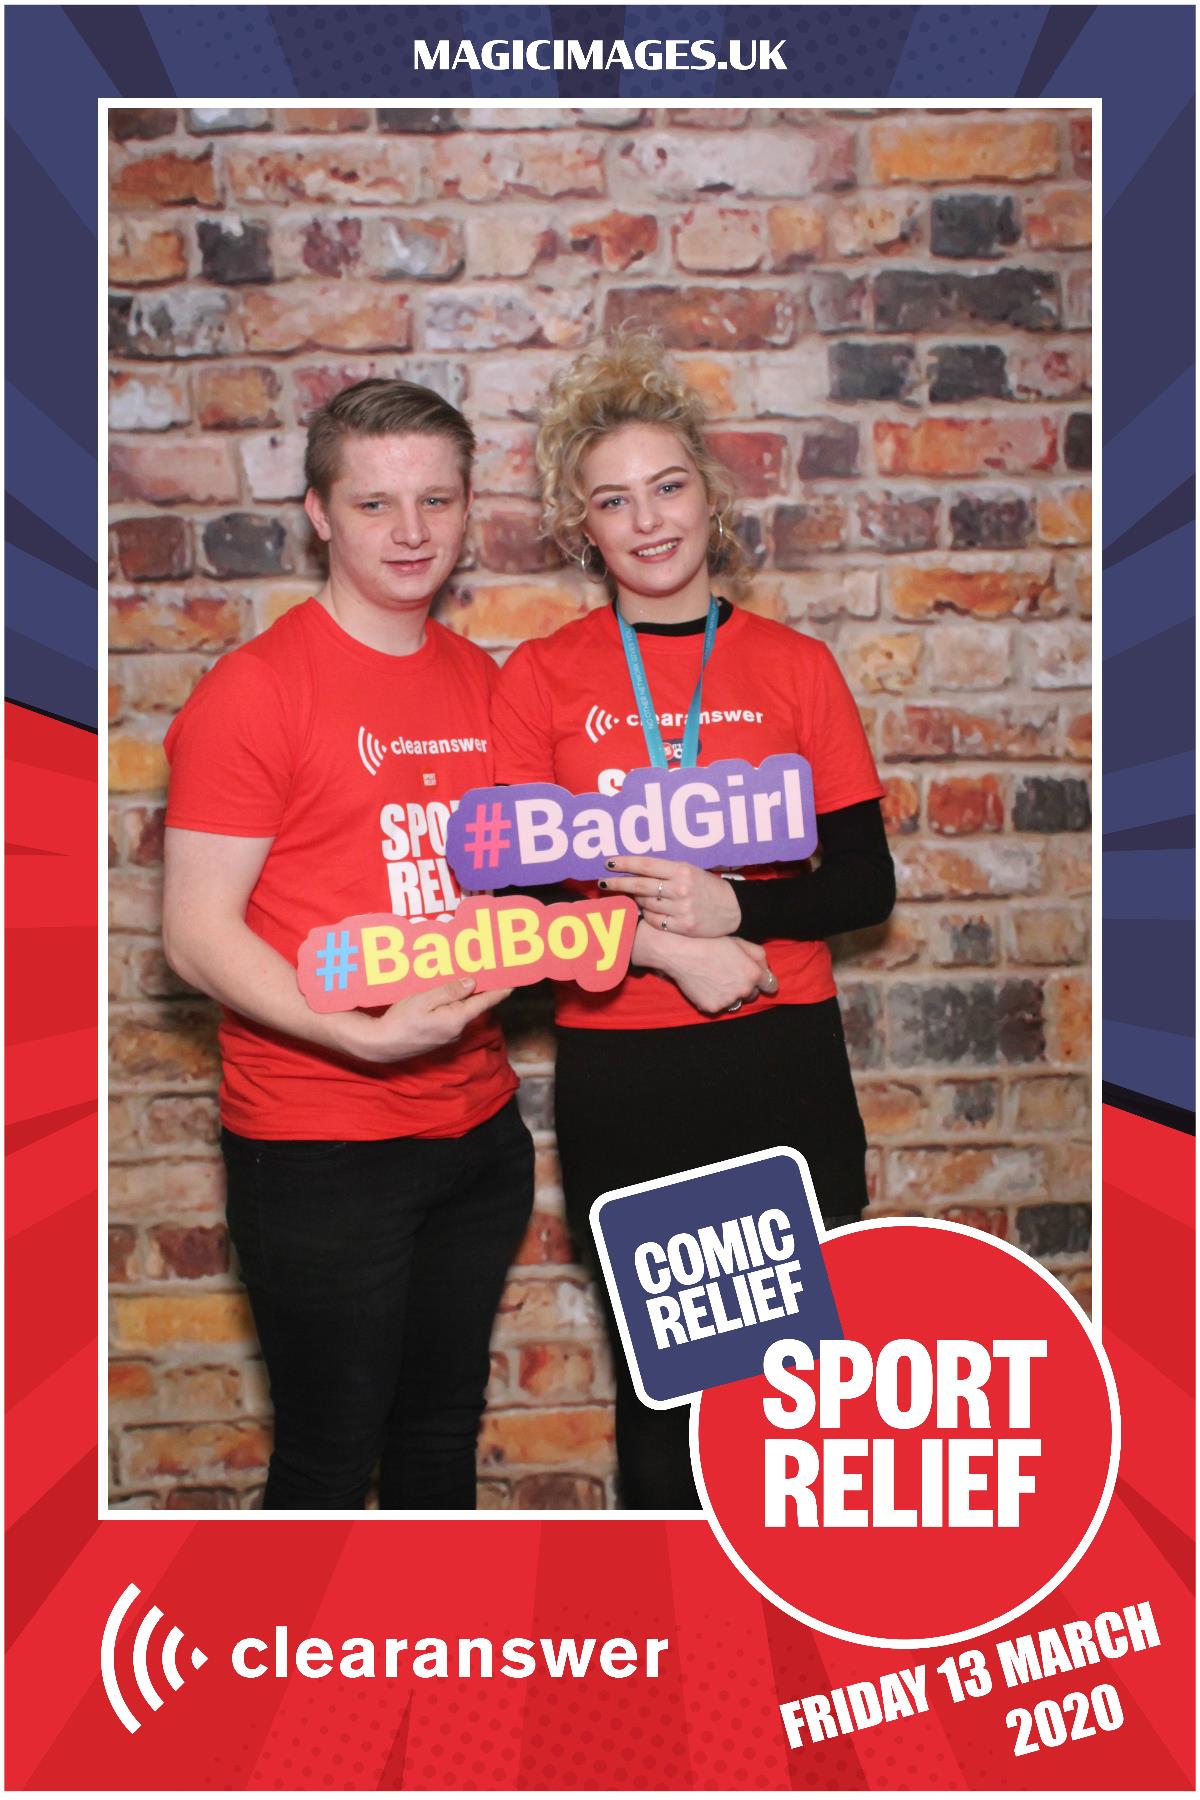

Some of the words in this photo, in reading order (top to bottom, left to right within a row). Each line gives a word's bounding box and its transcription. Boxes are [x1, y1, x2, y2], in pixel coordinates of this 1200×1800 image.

[390, 737, 487, 755] clearanswer
[626, 709, 763, 727] carnswer
[380, 800, 459, 861] SPO
[464, 769, 805, 869] #BadGirl
[386, 858, 462, 917] REL
[315, 907, 626, 992] #BadBoy
